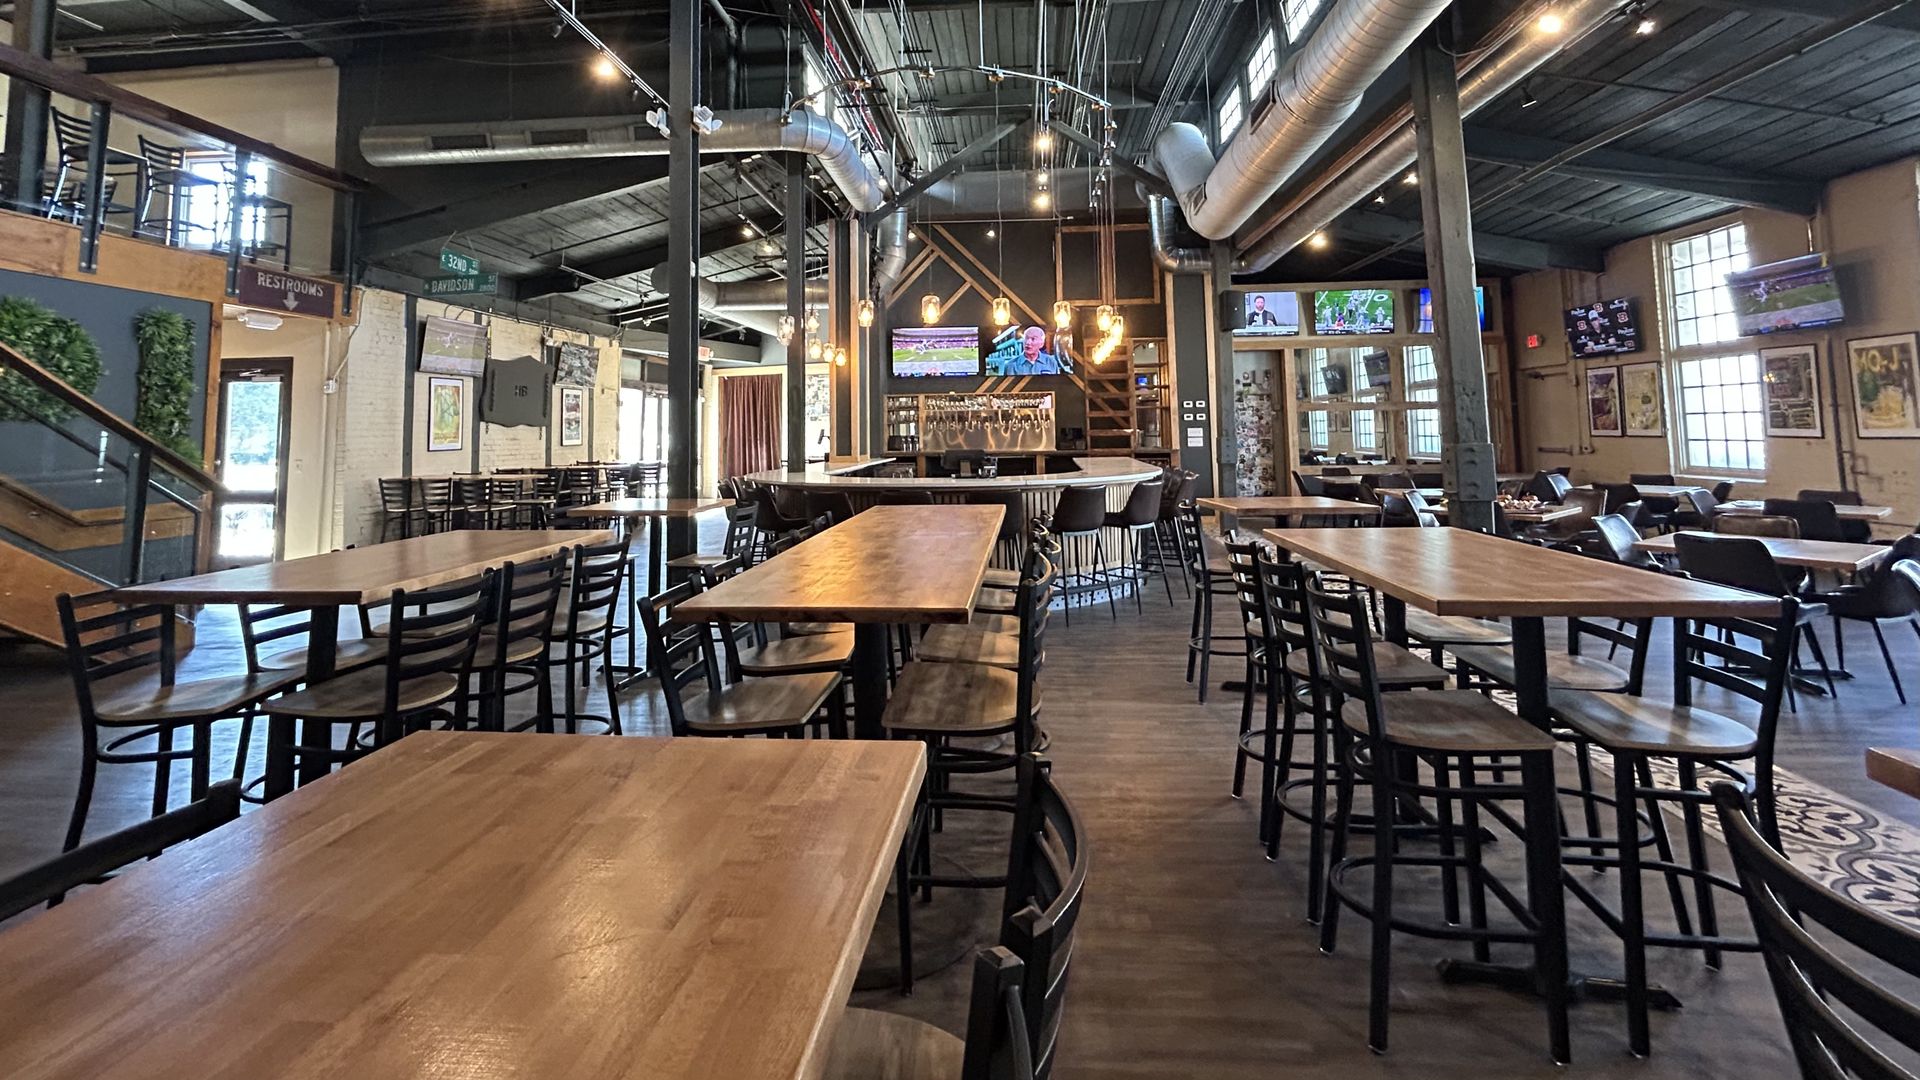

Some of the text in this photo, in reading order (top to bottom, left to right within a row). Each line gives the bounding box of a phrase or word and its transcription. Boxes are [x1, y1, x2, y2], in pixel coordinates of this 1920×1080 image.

[447, 254, 467, 272] 32ND
[257, 271, 324, 297] RESTROOMS
[431, 278, 475, 293] DAVIDSON
